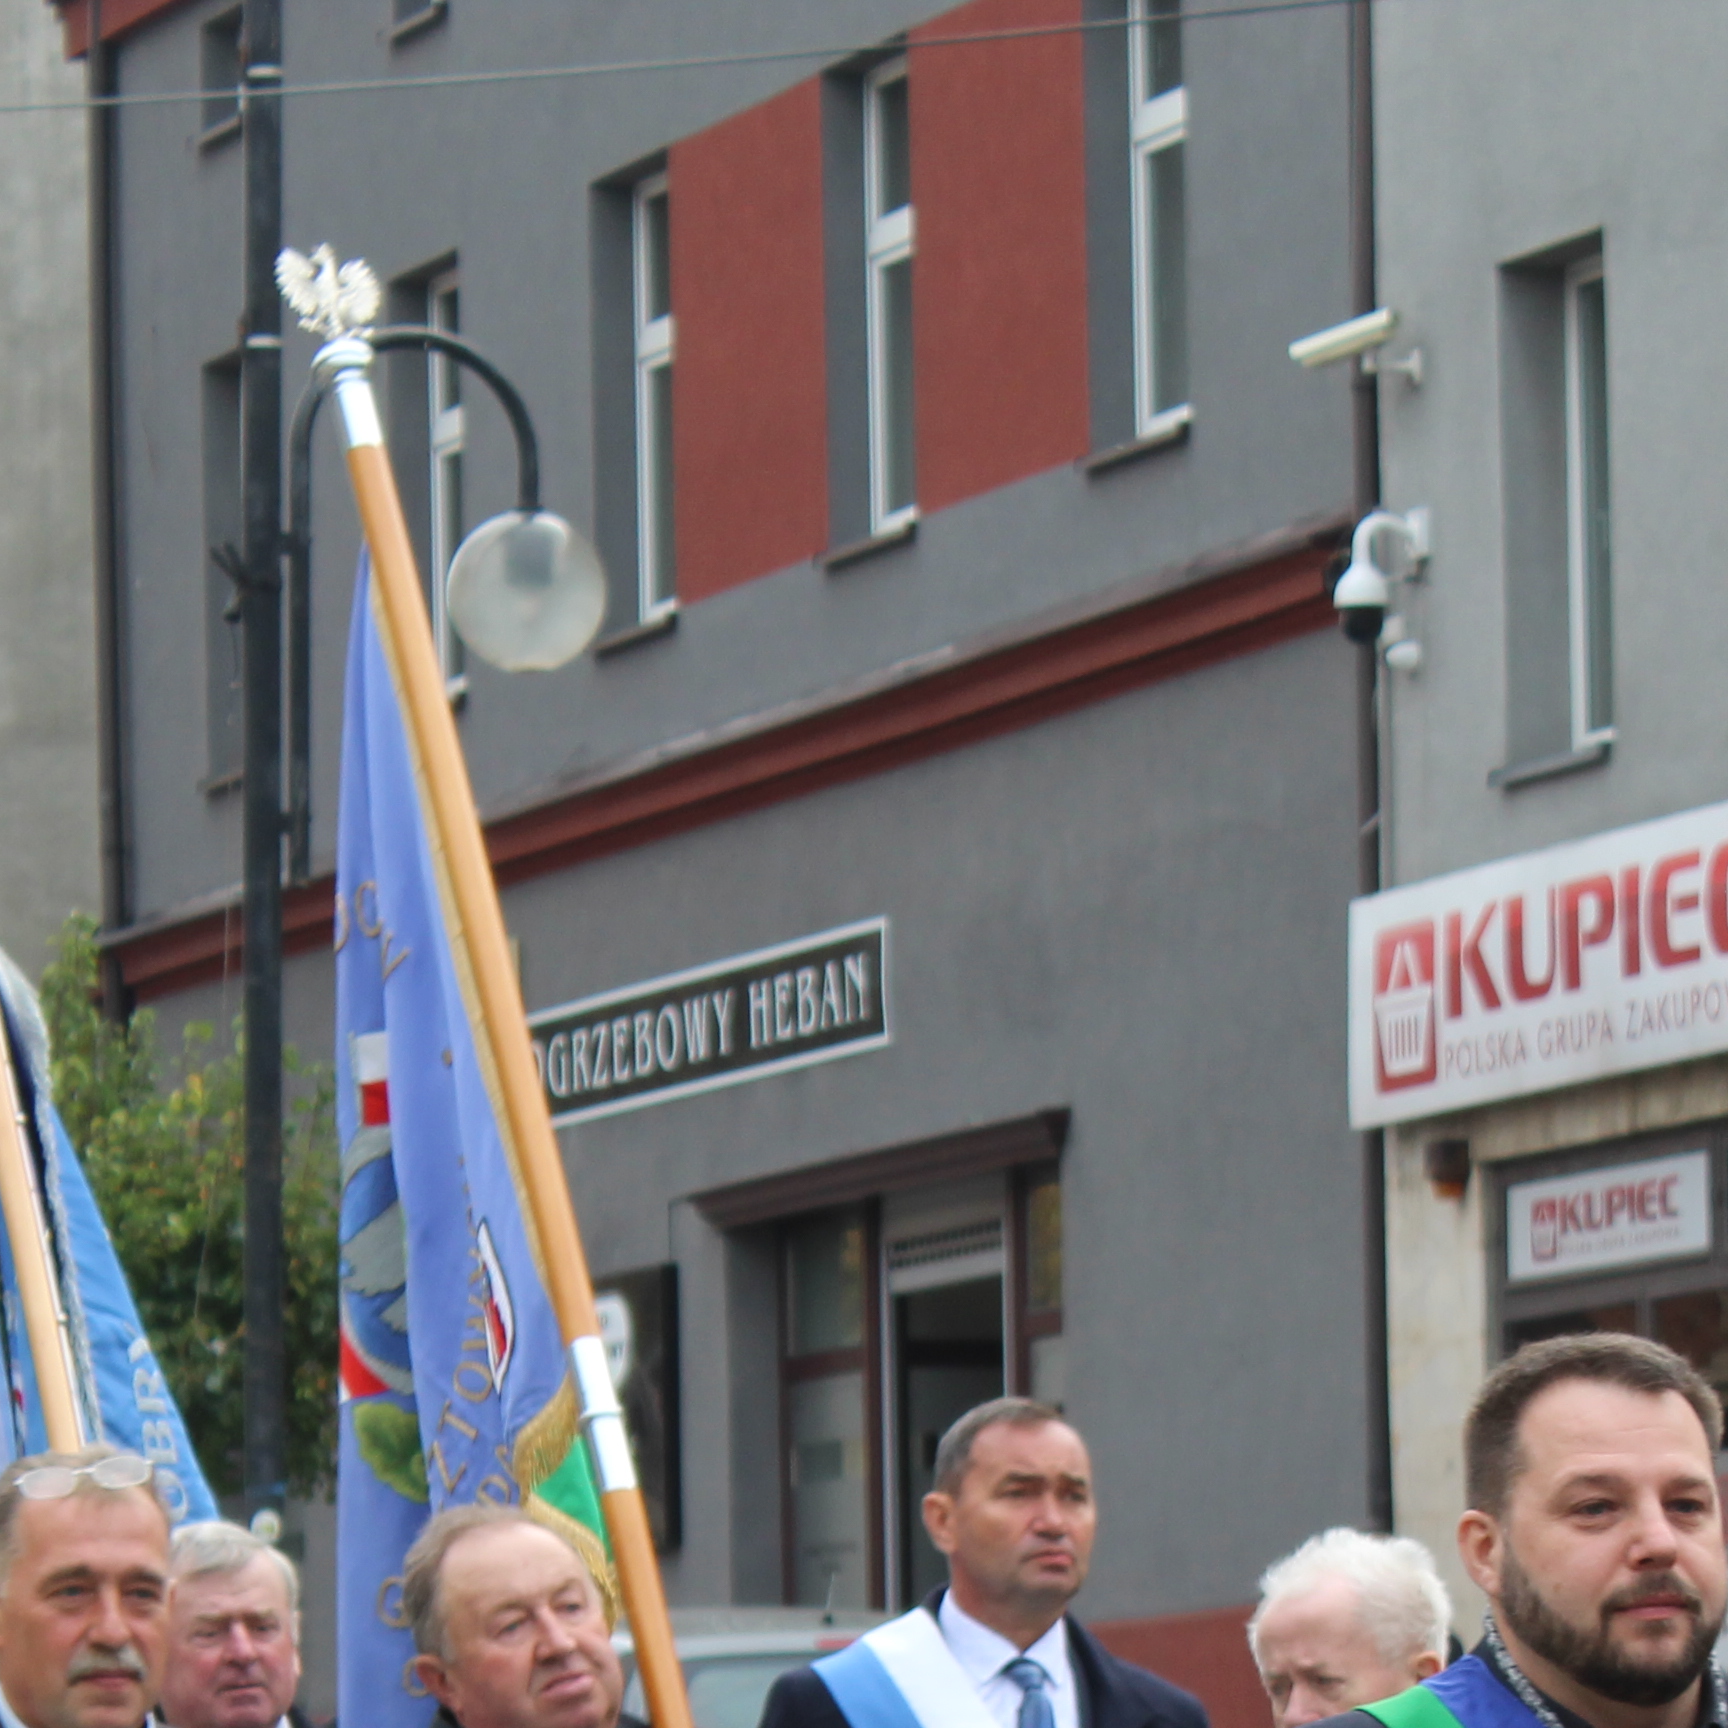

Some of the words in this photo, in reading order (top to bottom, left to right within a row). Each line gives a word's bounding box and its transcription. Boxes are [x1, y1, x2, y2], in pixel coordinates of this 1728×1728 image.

[748, 951, 870, 1049] HEBAN
[1445, 1028, 1527, 1080] POLSKA
[1537, 1009, 1614, 1060] GRUPA
[1556, 1174, 1678, 1237] KUPIEC
